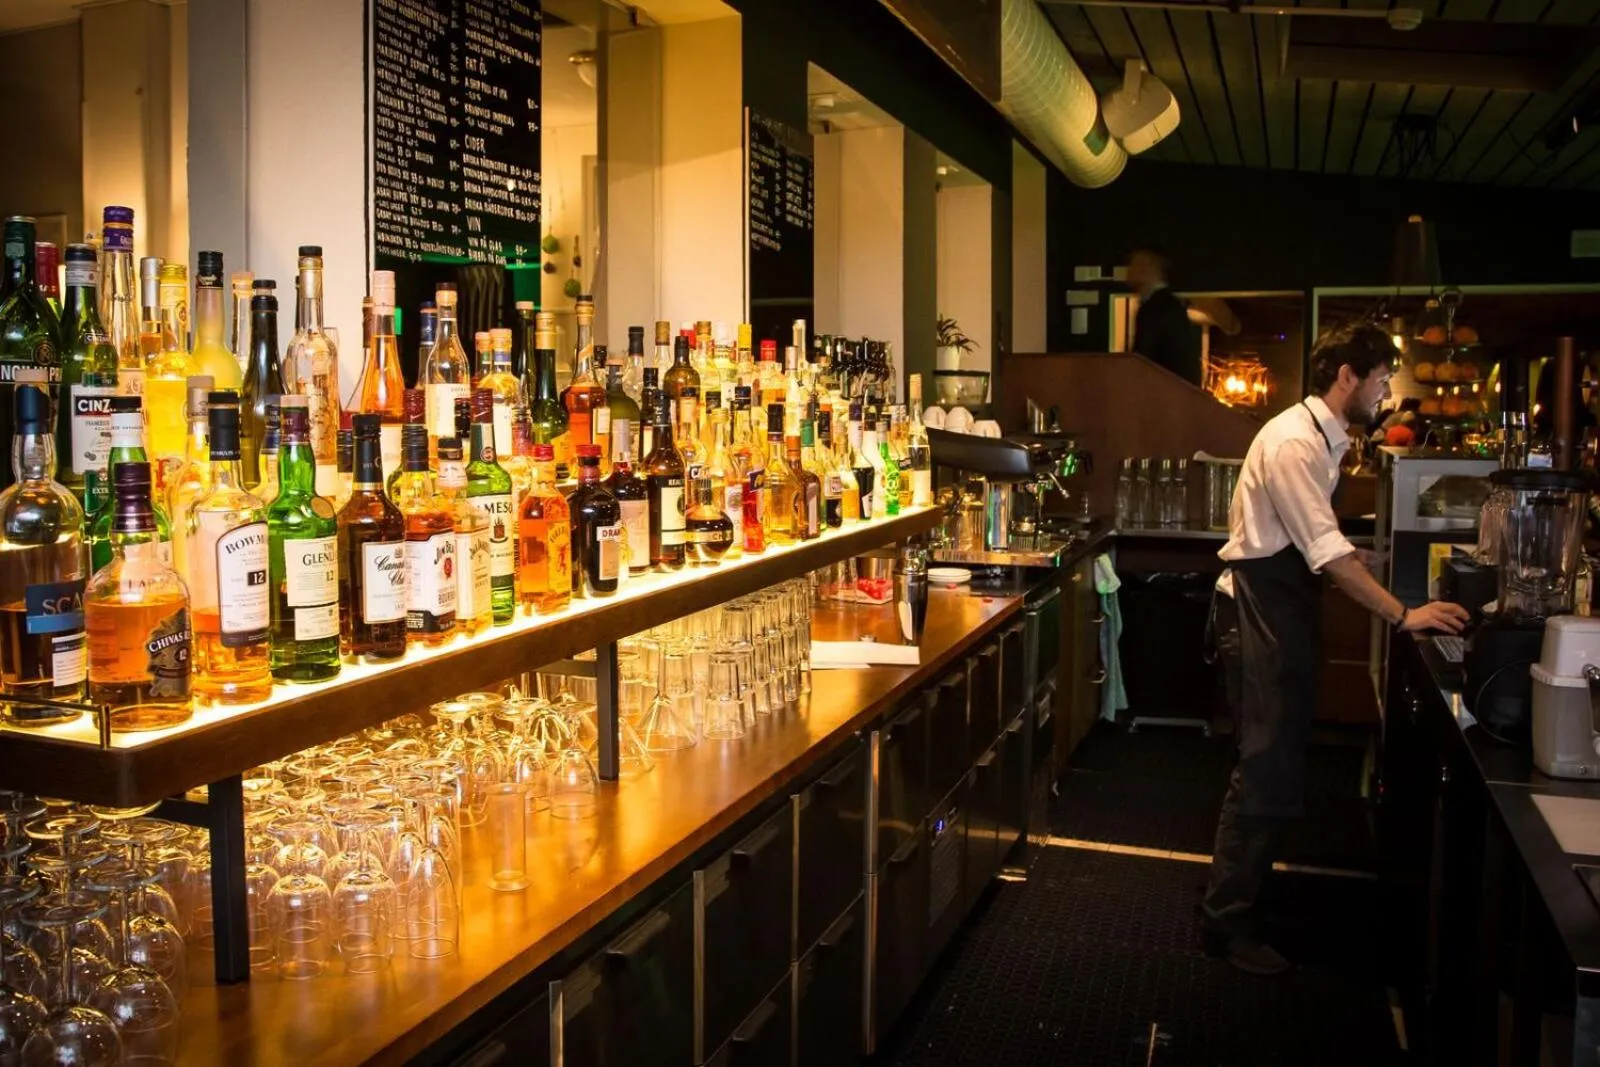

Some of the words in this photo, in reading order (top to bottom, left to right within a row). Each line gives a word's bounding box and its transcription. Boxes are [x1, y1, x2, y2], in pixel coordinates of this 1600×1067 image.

[78, 399, 114, 413] CINZ
[252, 571, 266, 585] 12
[148, 631, 184, 653] CHIVAS
